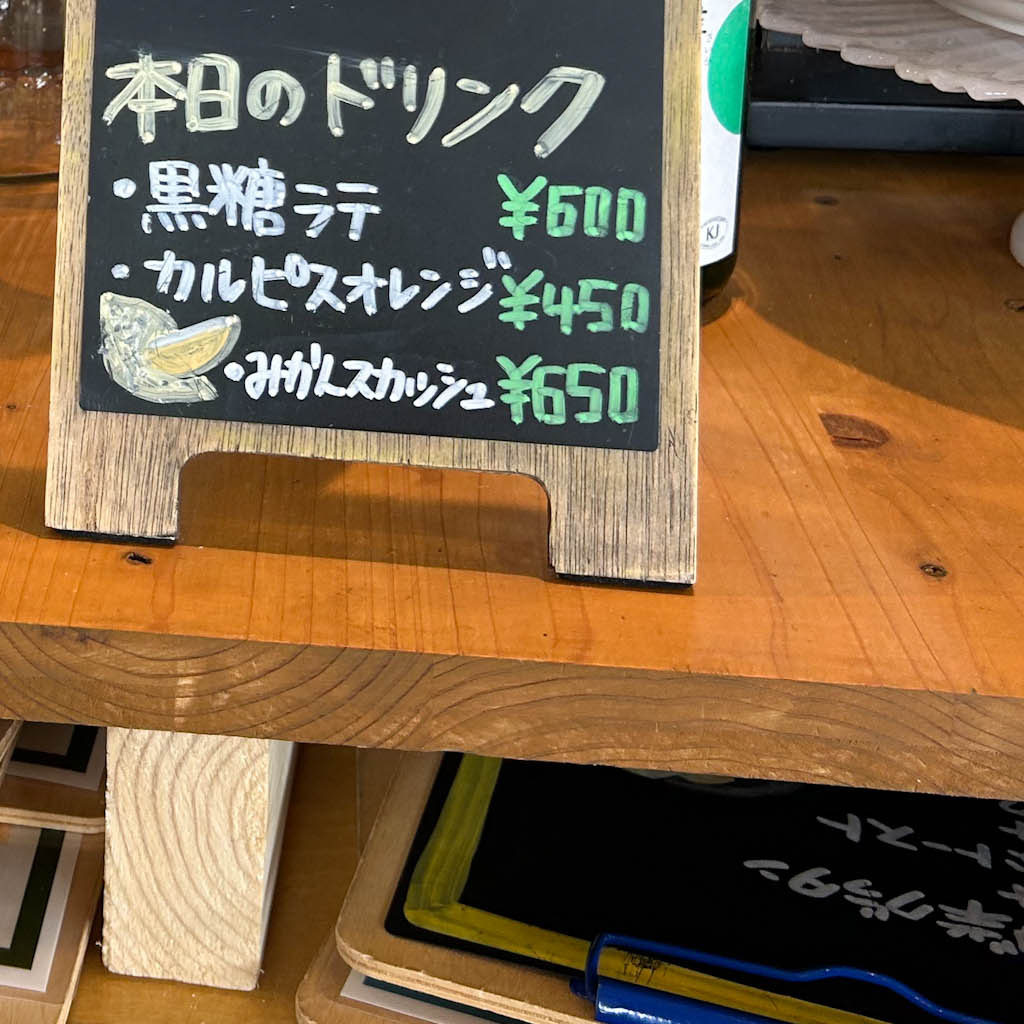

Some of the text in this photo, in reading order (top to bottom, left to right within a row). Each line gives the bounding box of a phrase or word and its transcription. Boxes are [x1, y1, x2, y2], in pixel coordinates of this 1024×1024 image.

[103, 53, 605, 158] 本日のドリンク
[497, 174, 647, 243] ¥600
[499, 269, 649, 334] ¥450
[496, 354, 640, 425] ¥650
